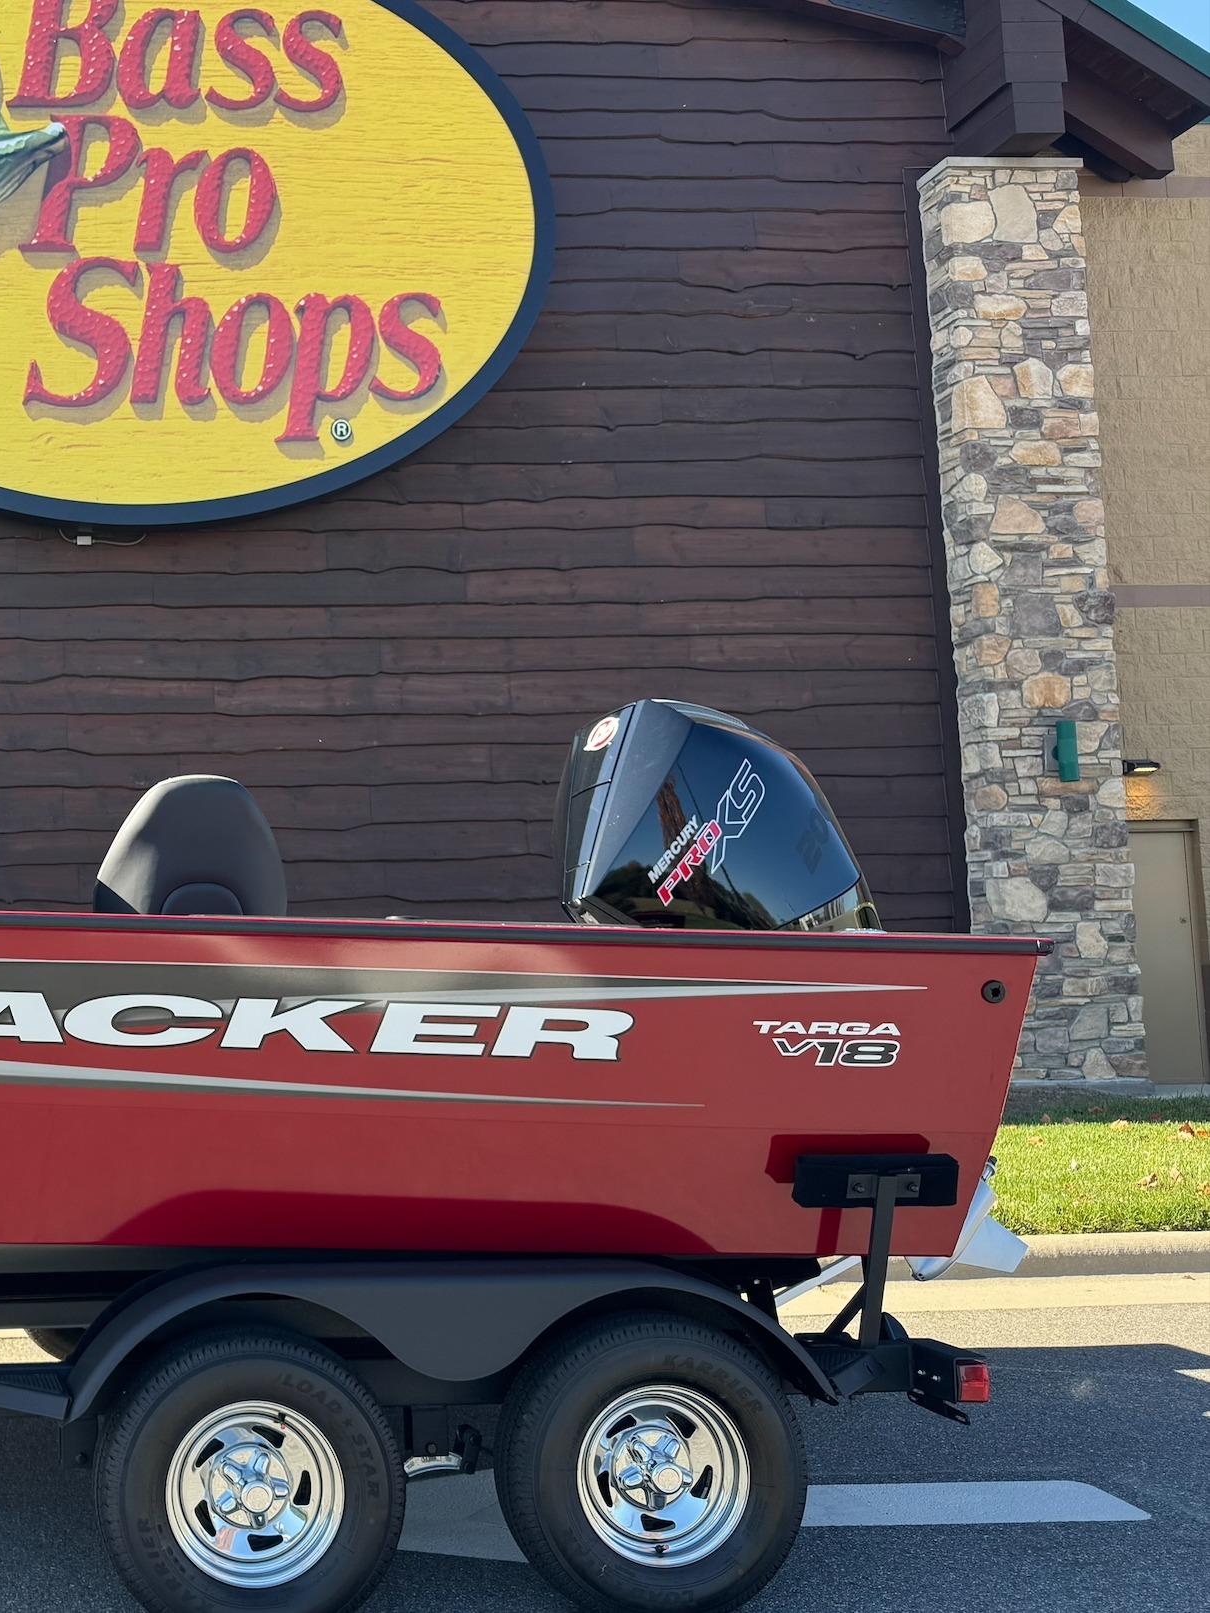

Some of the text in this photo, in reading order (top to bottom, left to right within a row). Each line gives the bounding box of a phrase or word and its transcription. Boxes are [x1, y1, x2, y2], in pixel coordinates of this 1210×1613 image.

[6, 0, 343, 111] Bass
[18, 113, 278, 254] Pro
[23, 256, 443, 443] Shops
[647, 814, 700, 884] MERCURY
[752, 1020, 902, 1037] TARGA
[771, 1037, 901, 1068] V18
